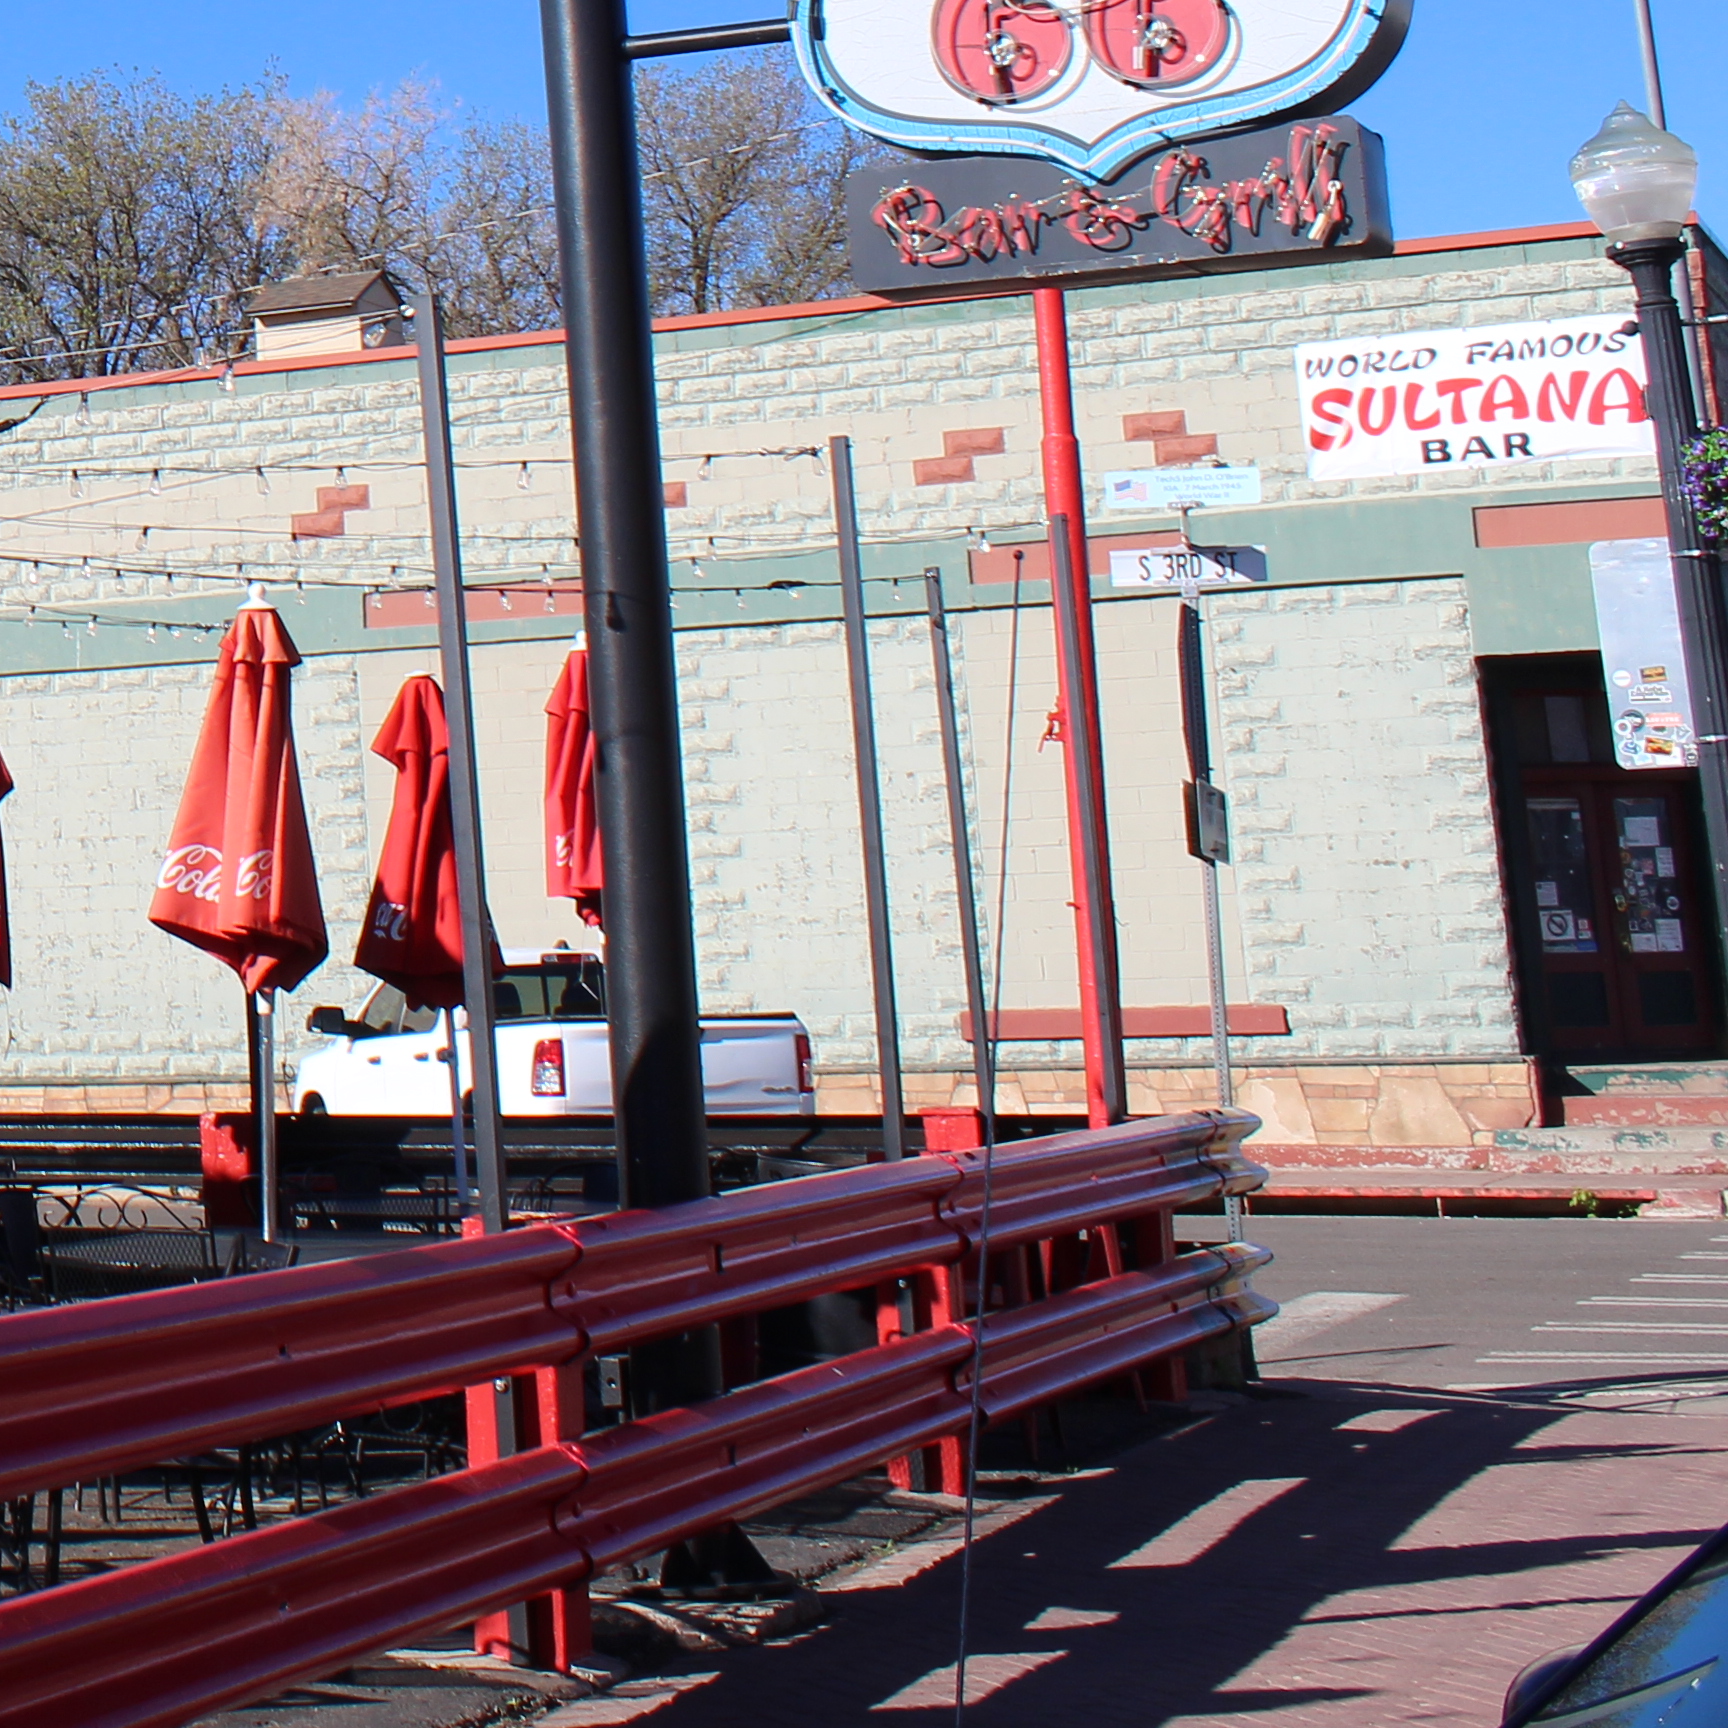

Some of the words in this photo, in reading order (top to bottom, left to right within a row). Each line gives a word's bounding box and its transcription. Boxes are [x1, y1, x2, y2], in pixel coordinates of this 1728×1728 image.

[870, 180, 1042, 265] Bar
[1150, 123, 1350, 250] Grill
[1304, 347, 1437, 379] WORLD
[1465, 331, 1628, 365] FAMOUS
[1309, 367, 1650, 452] SULTANA
[1421, 432, 1534, 464] BAR
[1138, 556, 1151, 581] S
[1162, 553, 1202, 581] 3RD
[1215, 551, 1237, 578] ST
